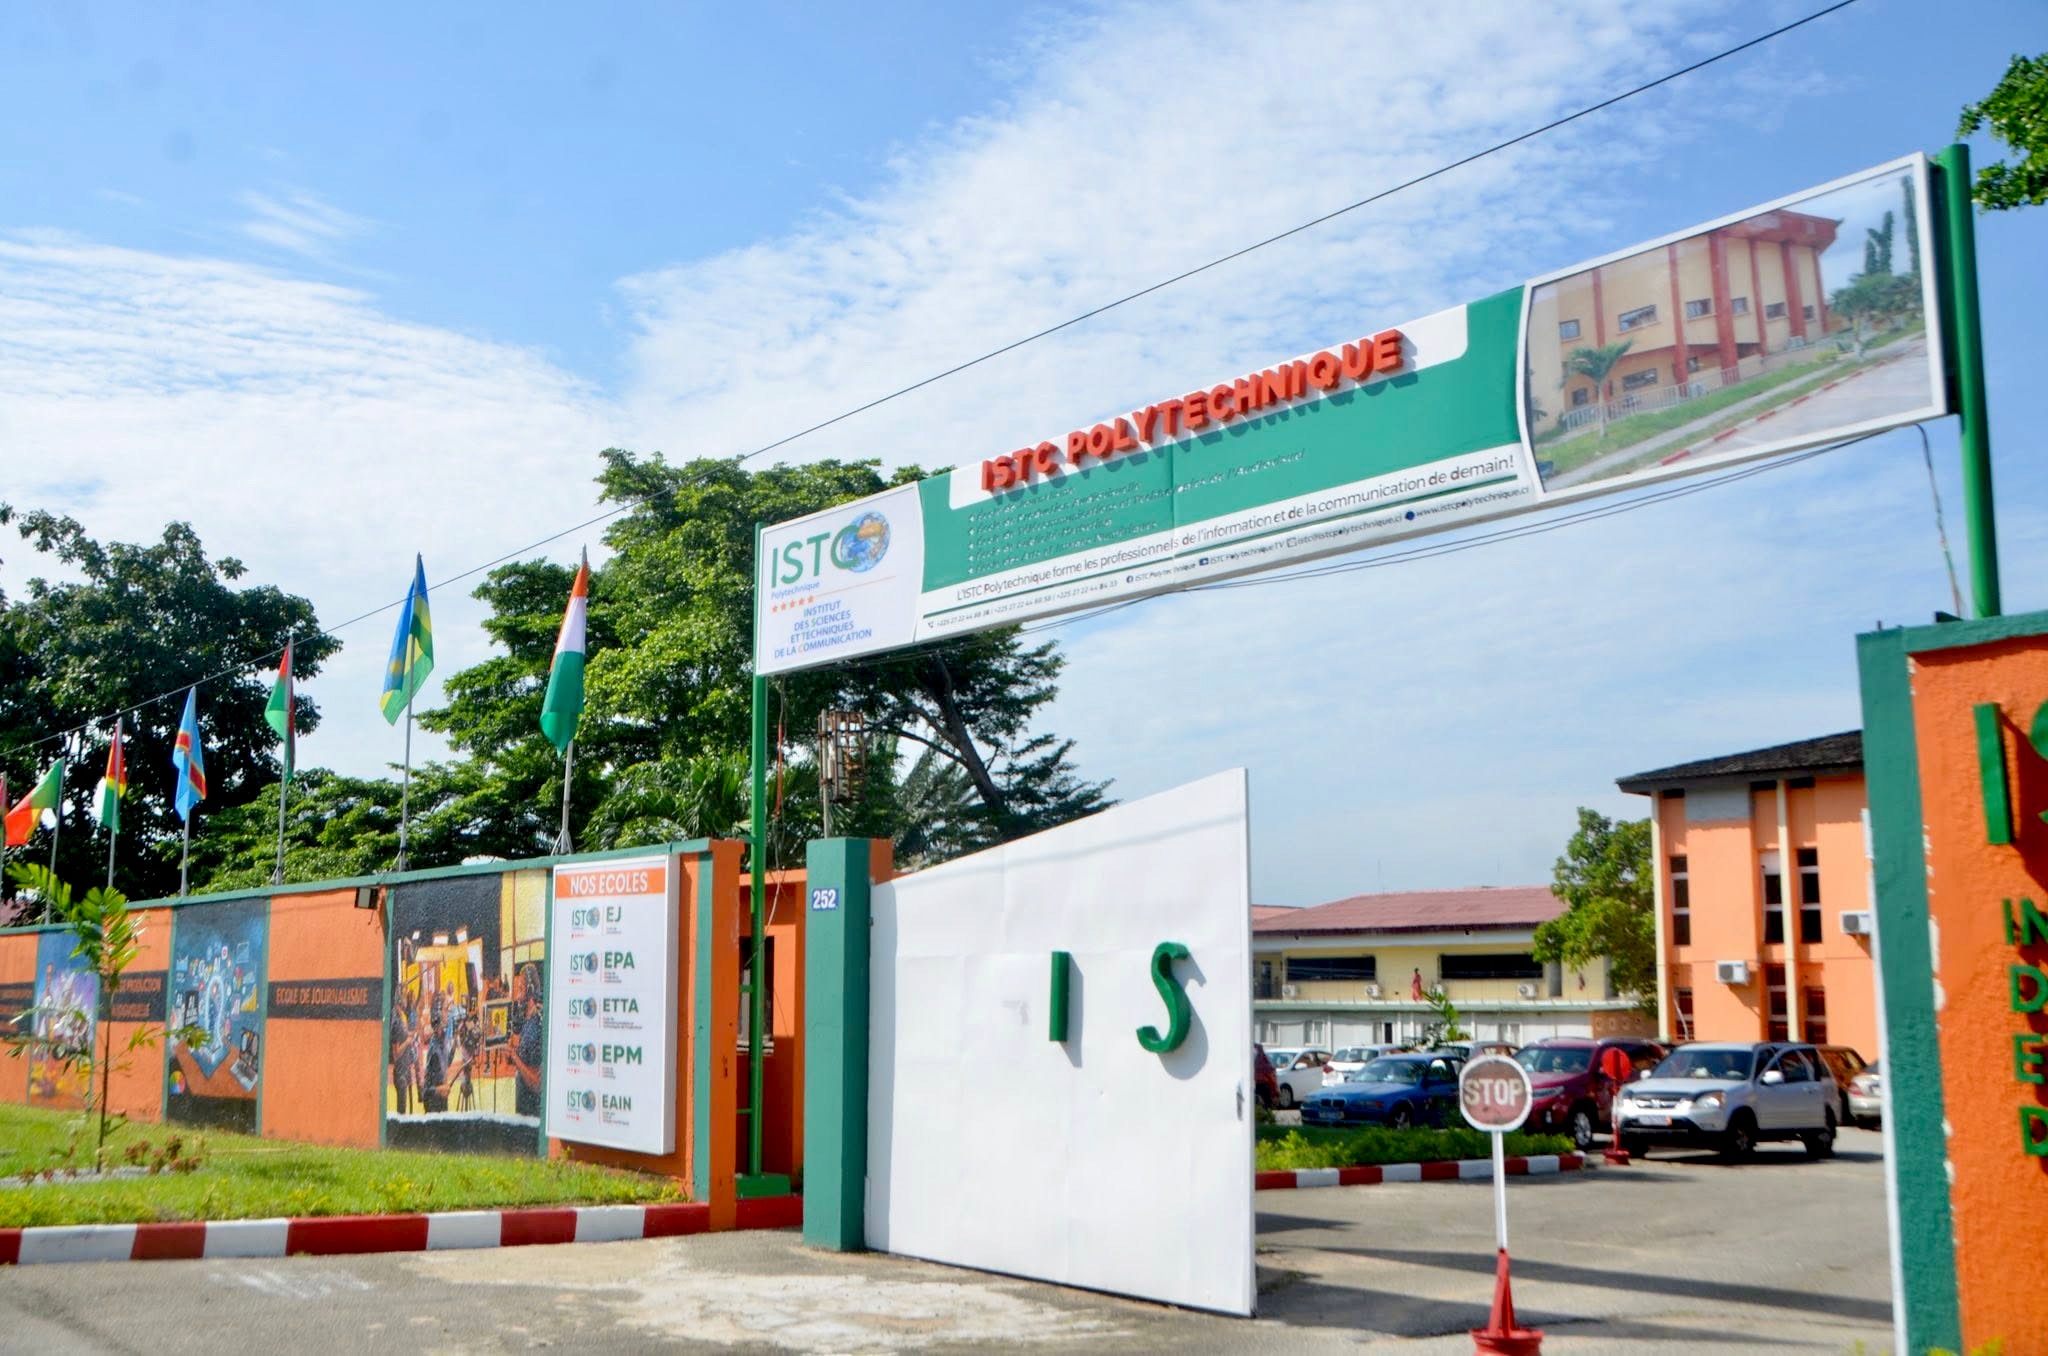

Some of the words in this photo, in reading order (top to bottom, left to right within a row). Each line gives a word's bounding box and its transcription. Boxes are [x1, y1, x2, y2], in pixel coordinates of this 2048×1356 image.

[981, 441, 1058, 492] ISTC
[1067, 329, 1403, 464] POLYTECHNIQUE
[984, 570, 1052, 594] Polytechnique
[1053, 563, 1082, 577] forme
[1085, 559, 1098, 569] les
[1101, 536, 1179, 569] professionnels
[1182, 533, 1196, 545] de
[1198, 516, 1272, 542] l'information
[1273, 511, 1286, 523] et
[1288, 506, 1304, 518] de
[1307, 503, 1317, 515] la
[1318, 477, 1425, 512] communication
[1428, 471, 1449, 485] de
[1450, 455, 1514, 481] demain!
[771, 581, 820, 600] Polytechnique
[803, 600, 841, 617] INSTITUT
[794, 618, 809, 631] DES
[811, 610, 851, 628] SCIENCES
[790, 631, 801, 644] ET
[801, 621, 854, 642] TECHNIQUES
[774, 647, 785, 659] DE
[787, 644, 798, 656] LA
[798, 629, 872, 654] COMMUNICATION
[570, 874, 596, 896] NOS
[598, 870, 648, 894] ECOLES
[813, 889, 836, 909] 252
[606, 906, 621, 923] EJ
[604, 951, 635, 969] EPA
[311, 986, 369, 1004] JOURNALISME
[603, 998, 638, 1013] ETTA
[602, 1045, 642, 1065] EPM
[1464, 1077, 1524, 1107] STOP
[602, 1094, 631, 1112] EAIN
